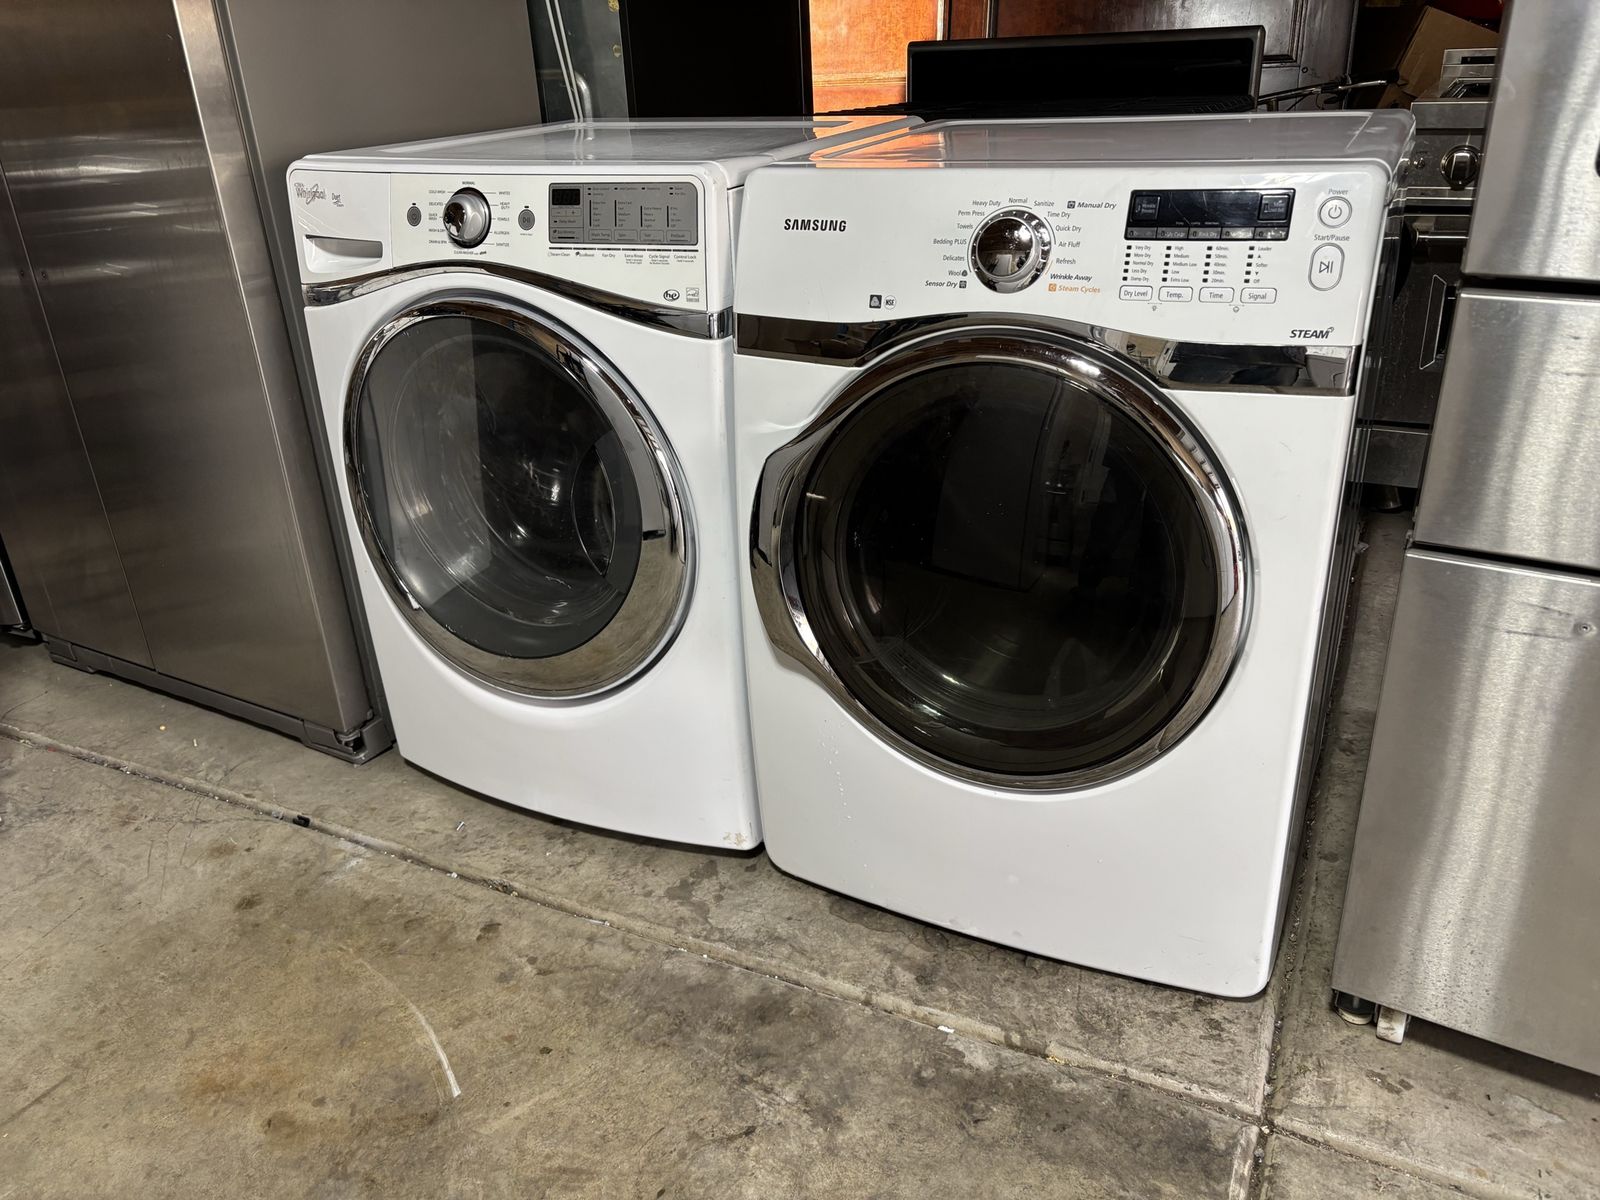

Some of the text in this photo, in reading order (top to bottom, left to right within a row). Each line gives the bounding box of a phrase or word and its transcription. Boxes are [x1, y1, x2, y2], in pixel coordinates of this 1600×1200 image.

[1104, 202, 1117, 210] Dry
[1061, 211, 1070, 219] Dry
[783, 218, 847, 232] SAMSUNG
[1074, 274, 1093, 282] Away
[1124, 290, 1133, 298] Dry
[1166, 291, 1184, 299] Temp.
[1248, 293, 1267, 301] Signal
[1290, 329, 1329, 339] STEAM
